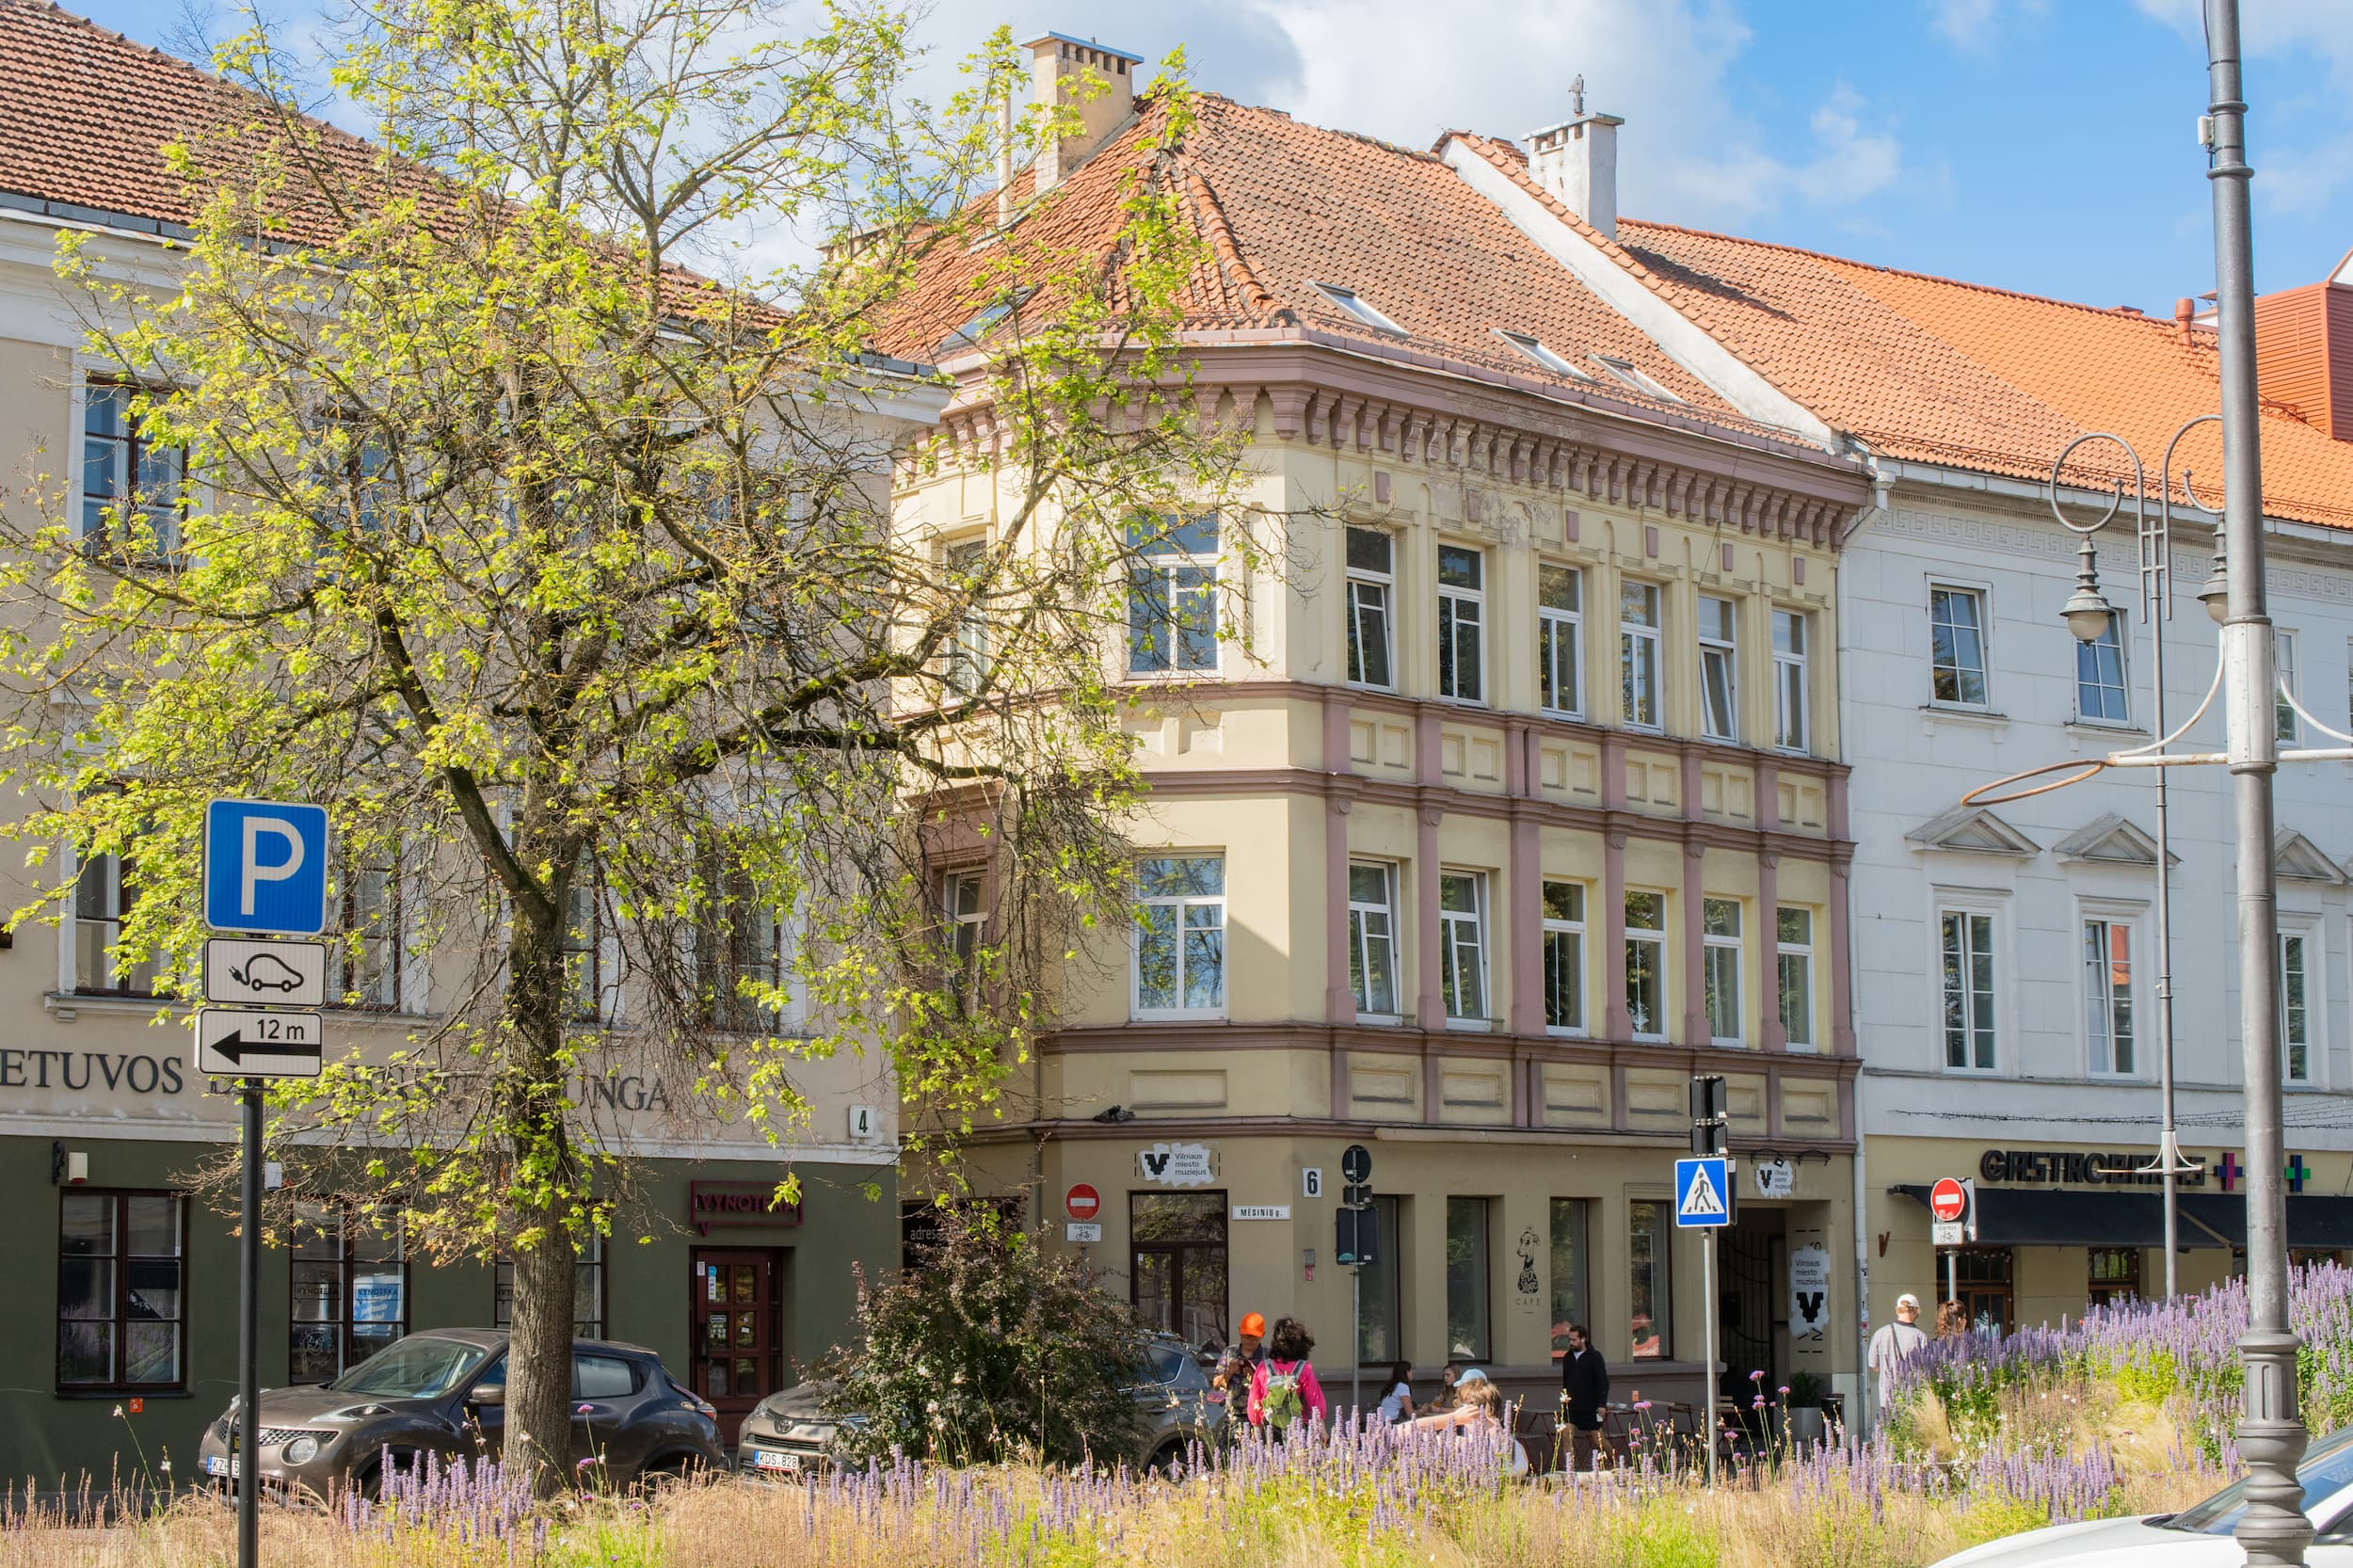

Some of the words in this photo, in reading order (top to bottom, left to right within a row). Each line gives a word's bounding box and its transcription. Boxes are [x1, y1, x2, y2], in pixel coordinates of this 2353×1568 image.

[241, 816, 305, 916] P
[257, 1019, 280, 1039] 12
[286, 1025, 305, 1040] m
[0, 1048, 184, 1095] ETUVOS
[858, 1110, 869, 1133] 4
[1144, 1153, 1170, 1176] V
[1306, 1171, 1318, 1195] 6
[1796, 1278, 1824, 1287] muziejus
[1796, 1292, 1824, 1323] V
[760, 1452, 776, 1466] KDS
[781, 1456, 797, 1468] 828
